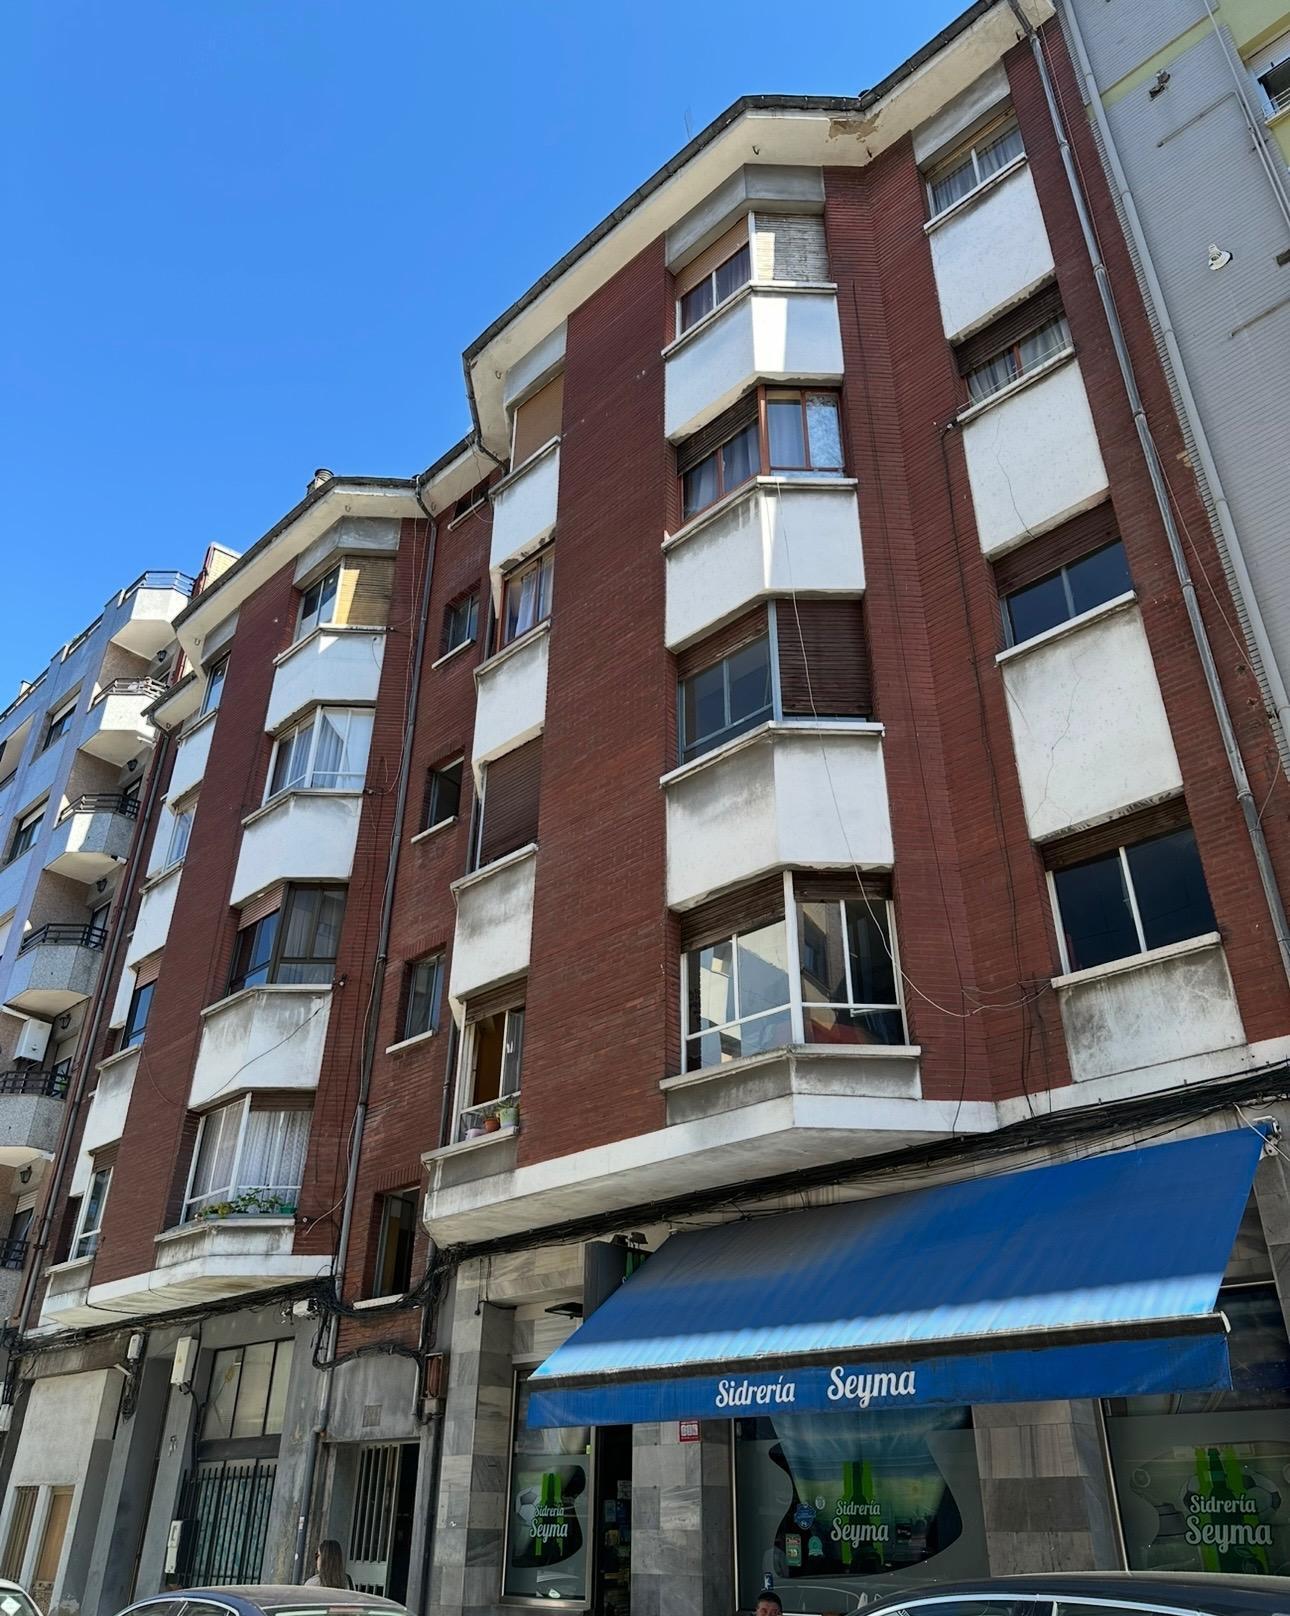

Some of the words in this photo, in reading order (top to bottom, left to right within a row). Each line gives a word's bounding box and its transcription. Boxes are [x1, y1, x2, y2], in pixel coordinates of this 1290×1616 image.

[715, 1375, 795, 1407] Sidrería
[827, 1366, 916, 1408] Seyma
[836, 1500, 881, 1516] Sidrería
[1189, 1494, 1257, 1513] Sidrería
[529, 1518, 569, 1544] Seyma
[830, 1517, 890, 1549] Seyma
[1185, 1515, 1273, 1554] Seyma
